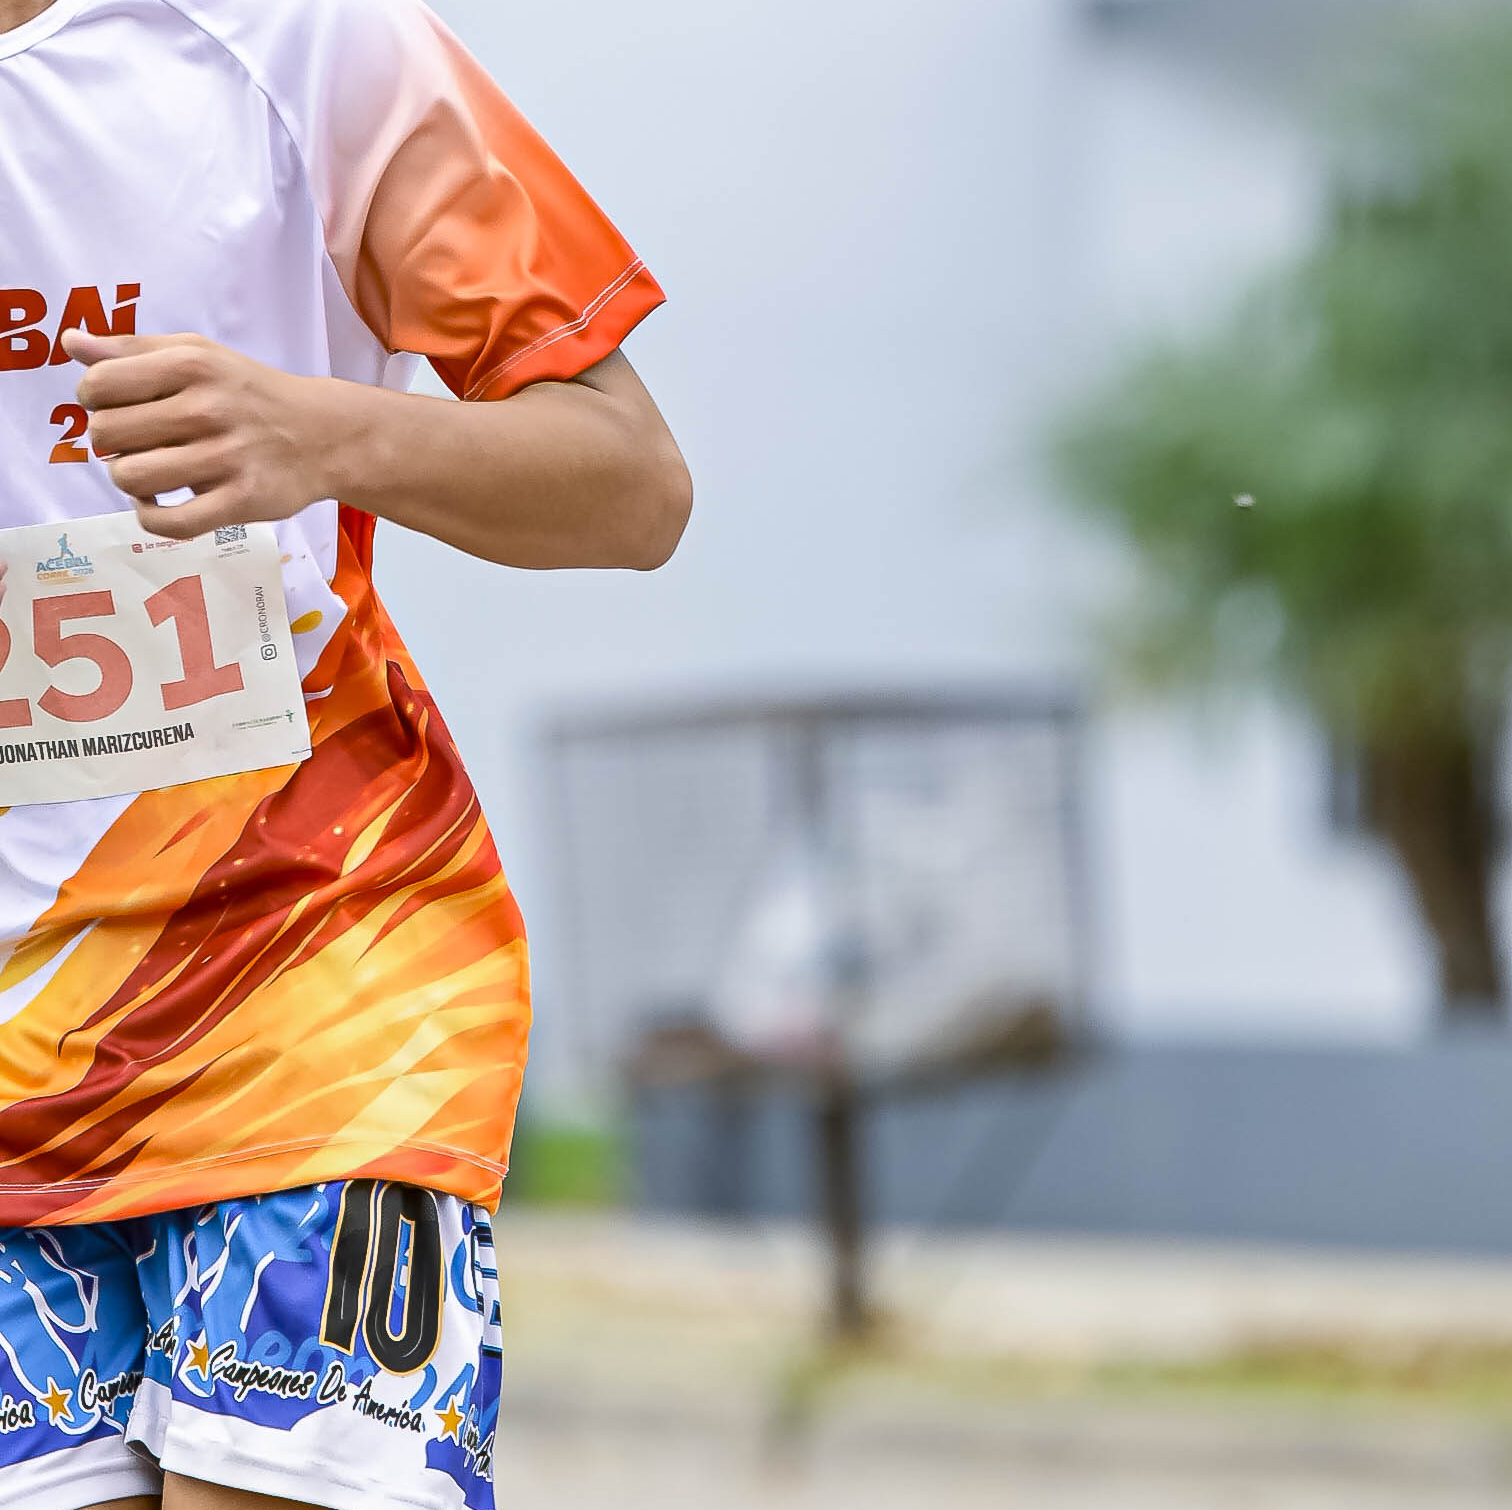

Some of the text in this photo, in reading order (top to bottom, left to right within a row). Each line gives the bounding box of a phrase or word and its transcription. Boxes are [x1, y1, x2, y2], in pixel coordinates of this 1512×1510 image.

[254, 586, 272, 642] @CRONORAV
[82, 722, 195, 757] MARIZCURENA
[319, 1179, 444, 1377] 10
[210, 1344, 315, 1399] Campeones
[319, 1363, 348, 1402] De
